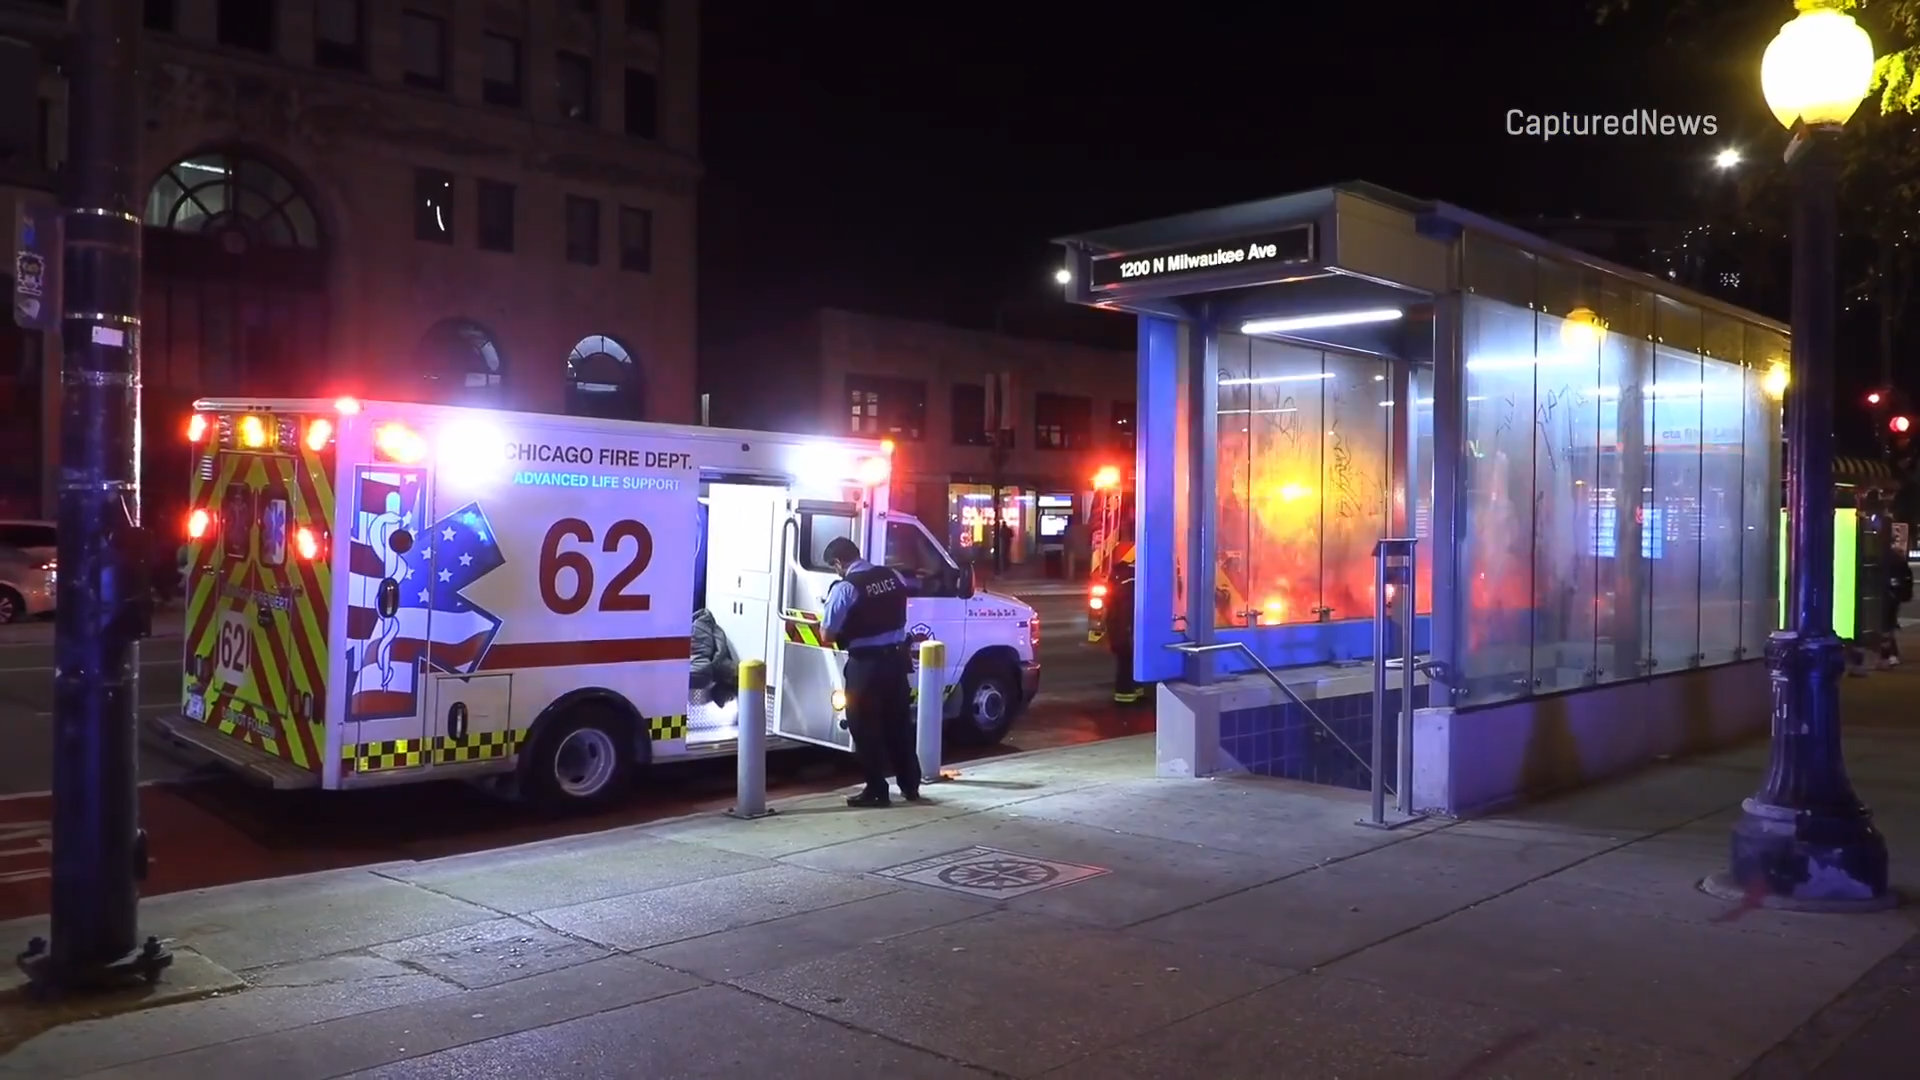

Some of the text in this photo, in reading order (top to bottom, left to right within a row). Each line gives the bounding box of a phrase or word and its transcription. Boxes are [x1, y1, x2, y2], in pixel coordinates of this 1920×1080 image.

[1120, 243, 1277, 277] 1200 N Milwaukee Ave
[504, 442, 692, 469] CHICAGO FIRE DEPT.
[514, 471, 680, 490] ADVANCED LIFE SUPPORT
[539, 517, 653, 615] 62
[866, 578, 896, 596] POLICE
